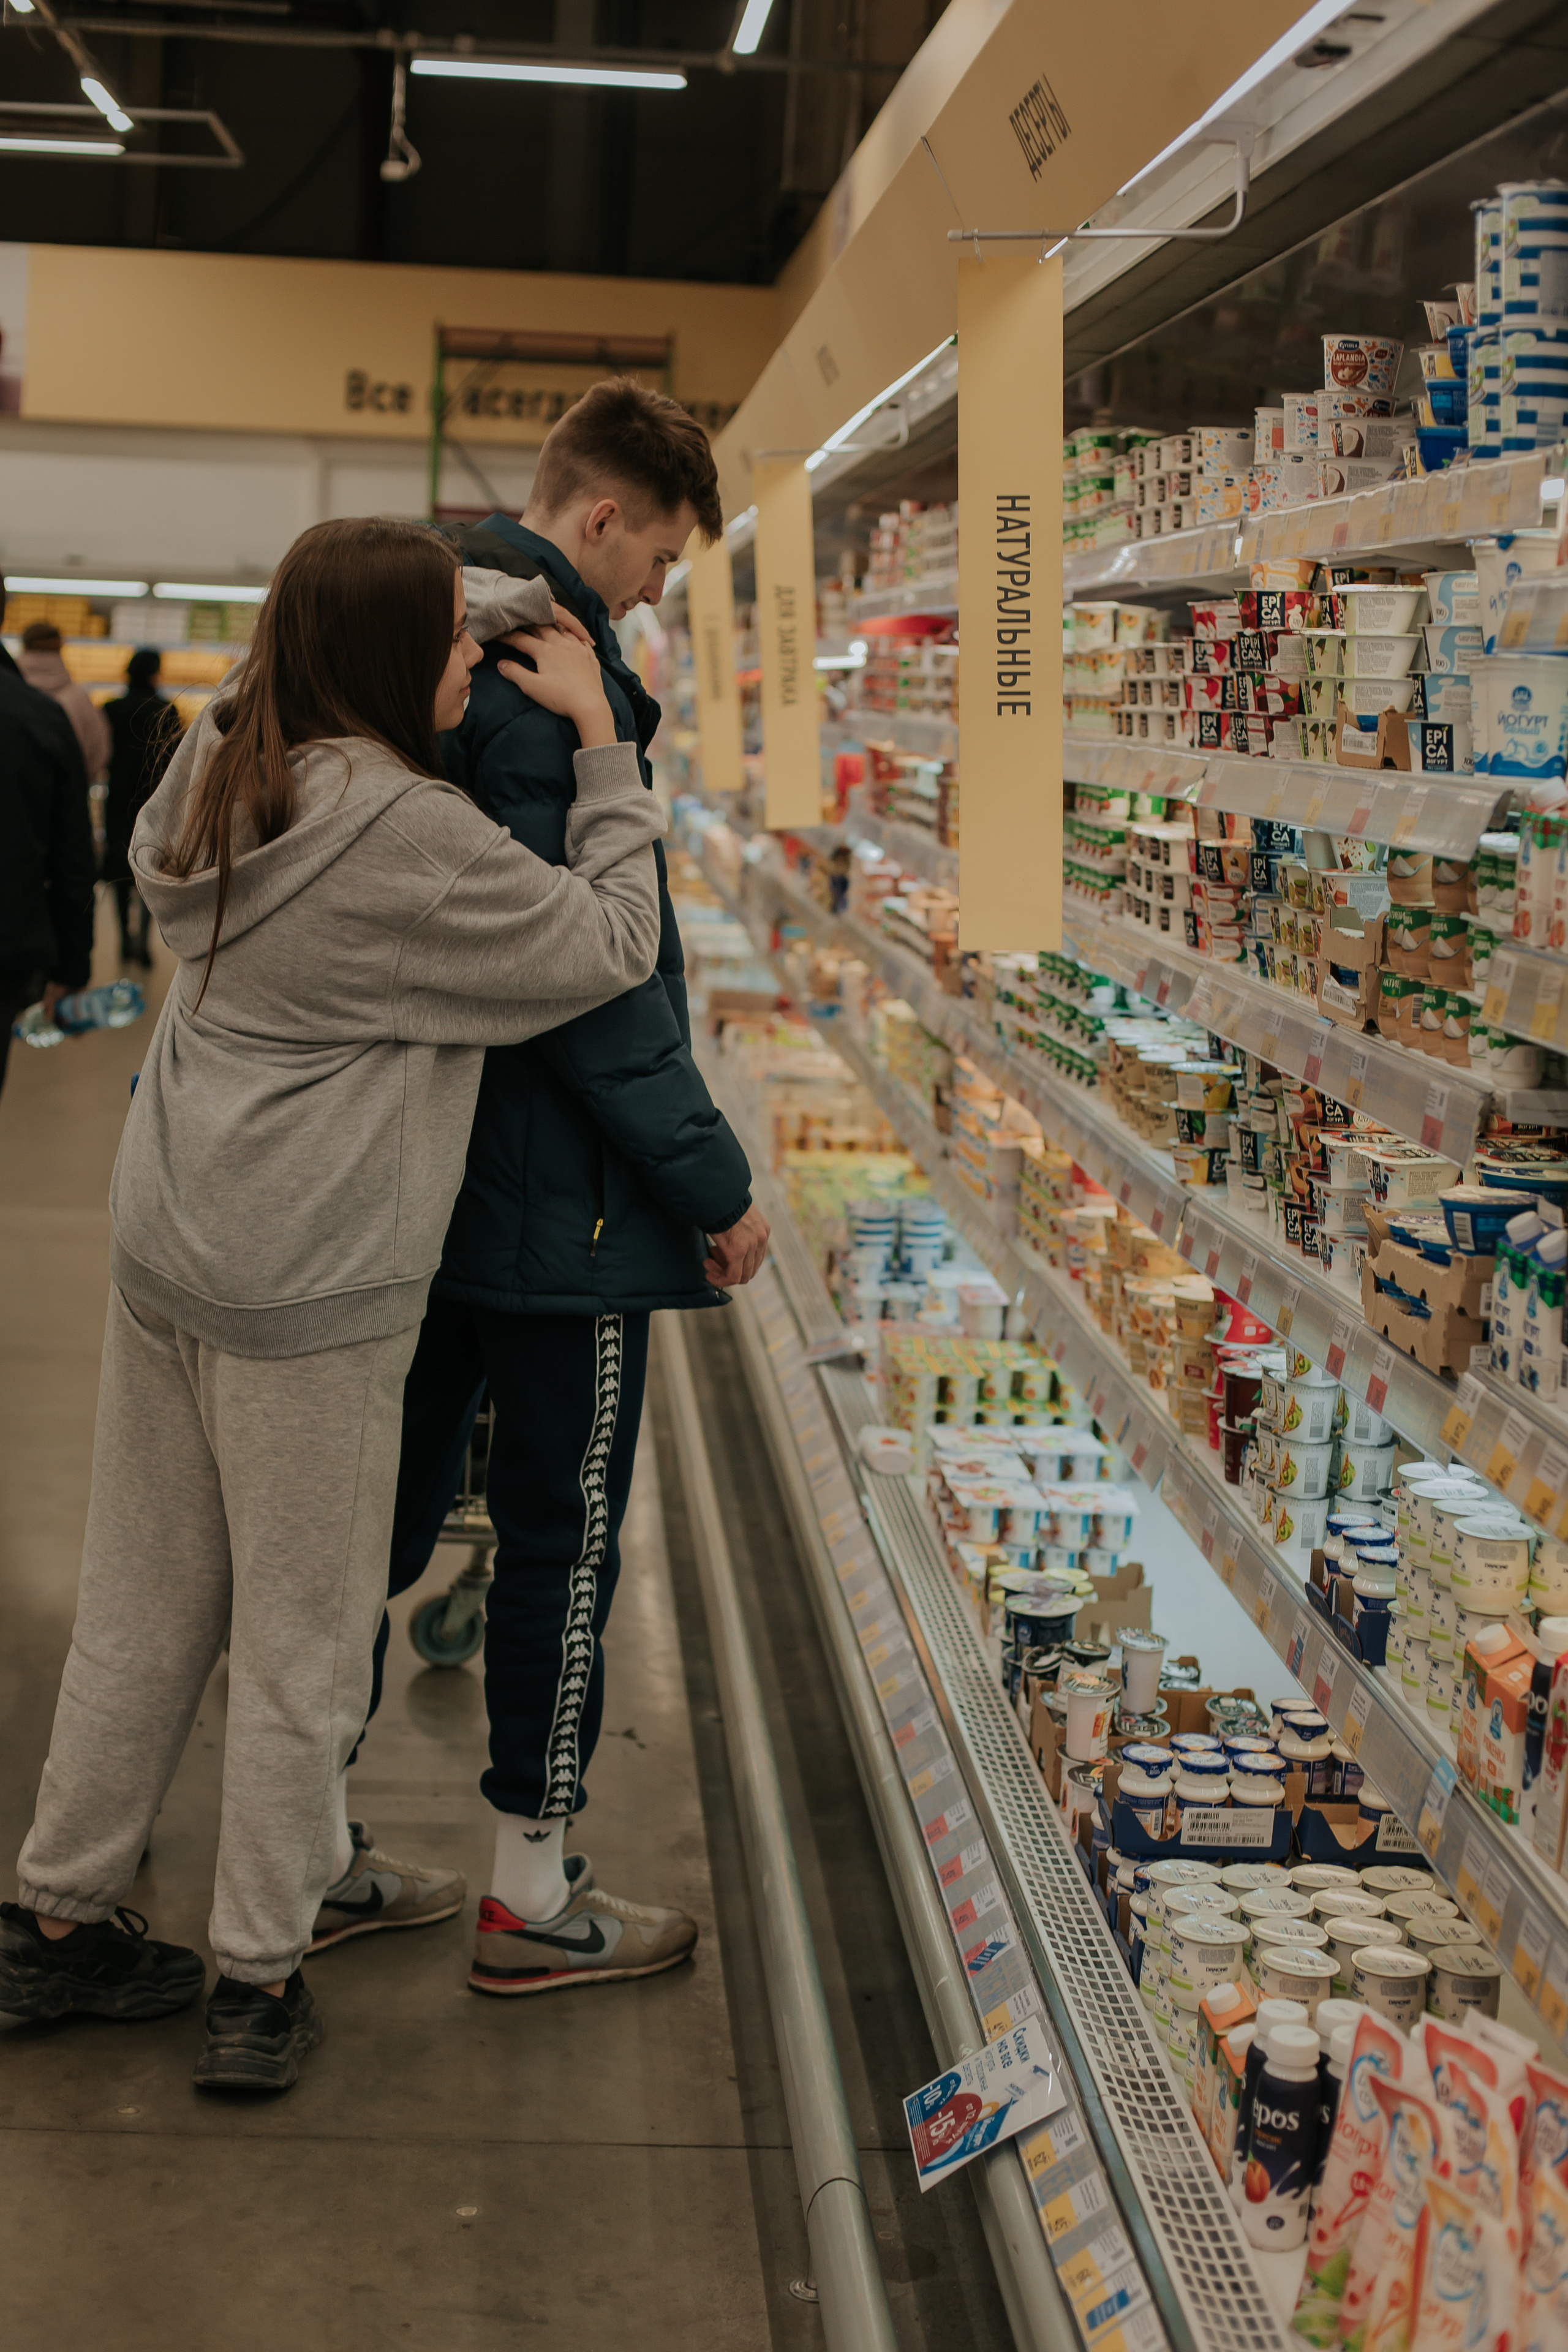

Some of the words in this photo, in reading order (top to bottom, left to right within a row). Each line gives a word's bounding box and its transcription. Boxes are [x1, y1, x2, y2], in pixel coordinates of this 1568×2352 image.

[1009, 72, 1071, 183] ДЕСЕРТЫ
[1332, 353, 1365, 362] LAPLANDIA
[996, 495, 1031, 716] НАТУРАЛЬНЫЕ
[1262, 593, 1281, 609] EPI
[1261, 608, 1281, 620] CA
[1498, 711, 1549, 728] ЙОГУРТ
[1426, 728, 1447, 744] EPI
[1425, 744, 1447, 758] CA
[1272, 831, 1290, 842] CA
[1253, 856, 1266, 870] EPI
[1254, 870, 1267, 881] CA
[1325, 1105, 1344, 1116] CA
[1242, 1135, 1254, 1148] EPI
[1242, 1147, 1254, 1158] CA
[997, 2038, 1008, 2055] на
[1012, 2027, 1030, 2064] Скидки
[1000, 2052, 1013, 2069] все
